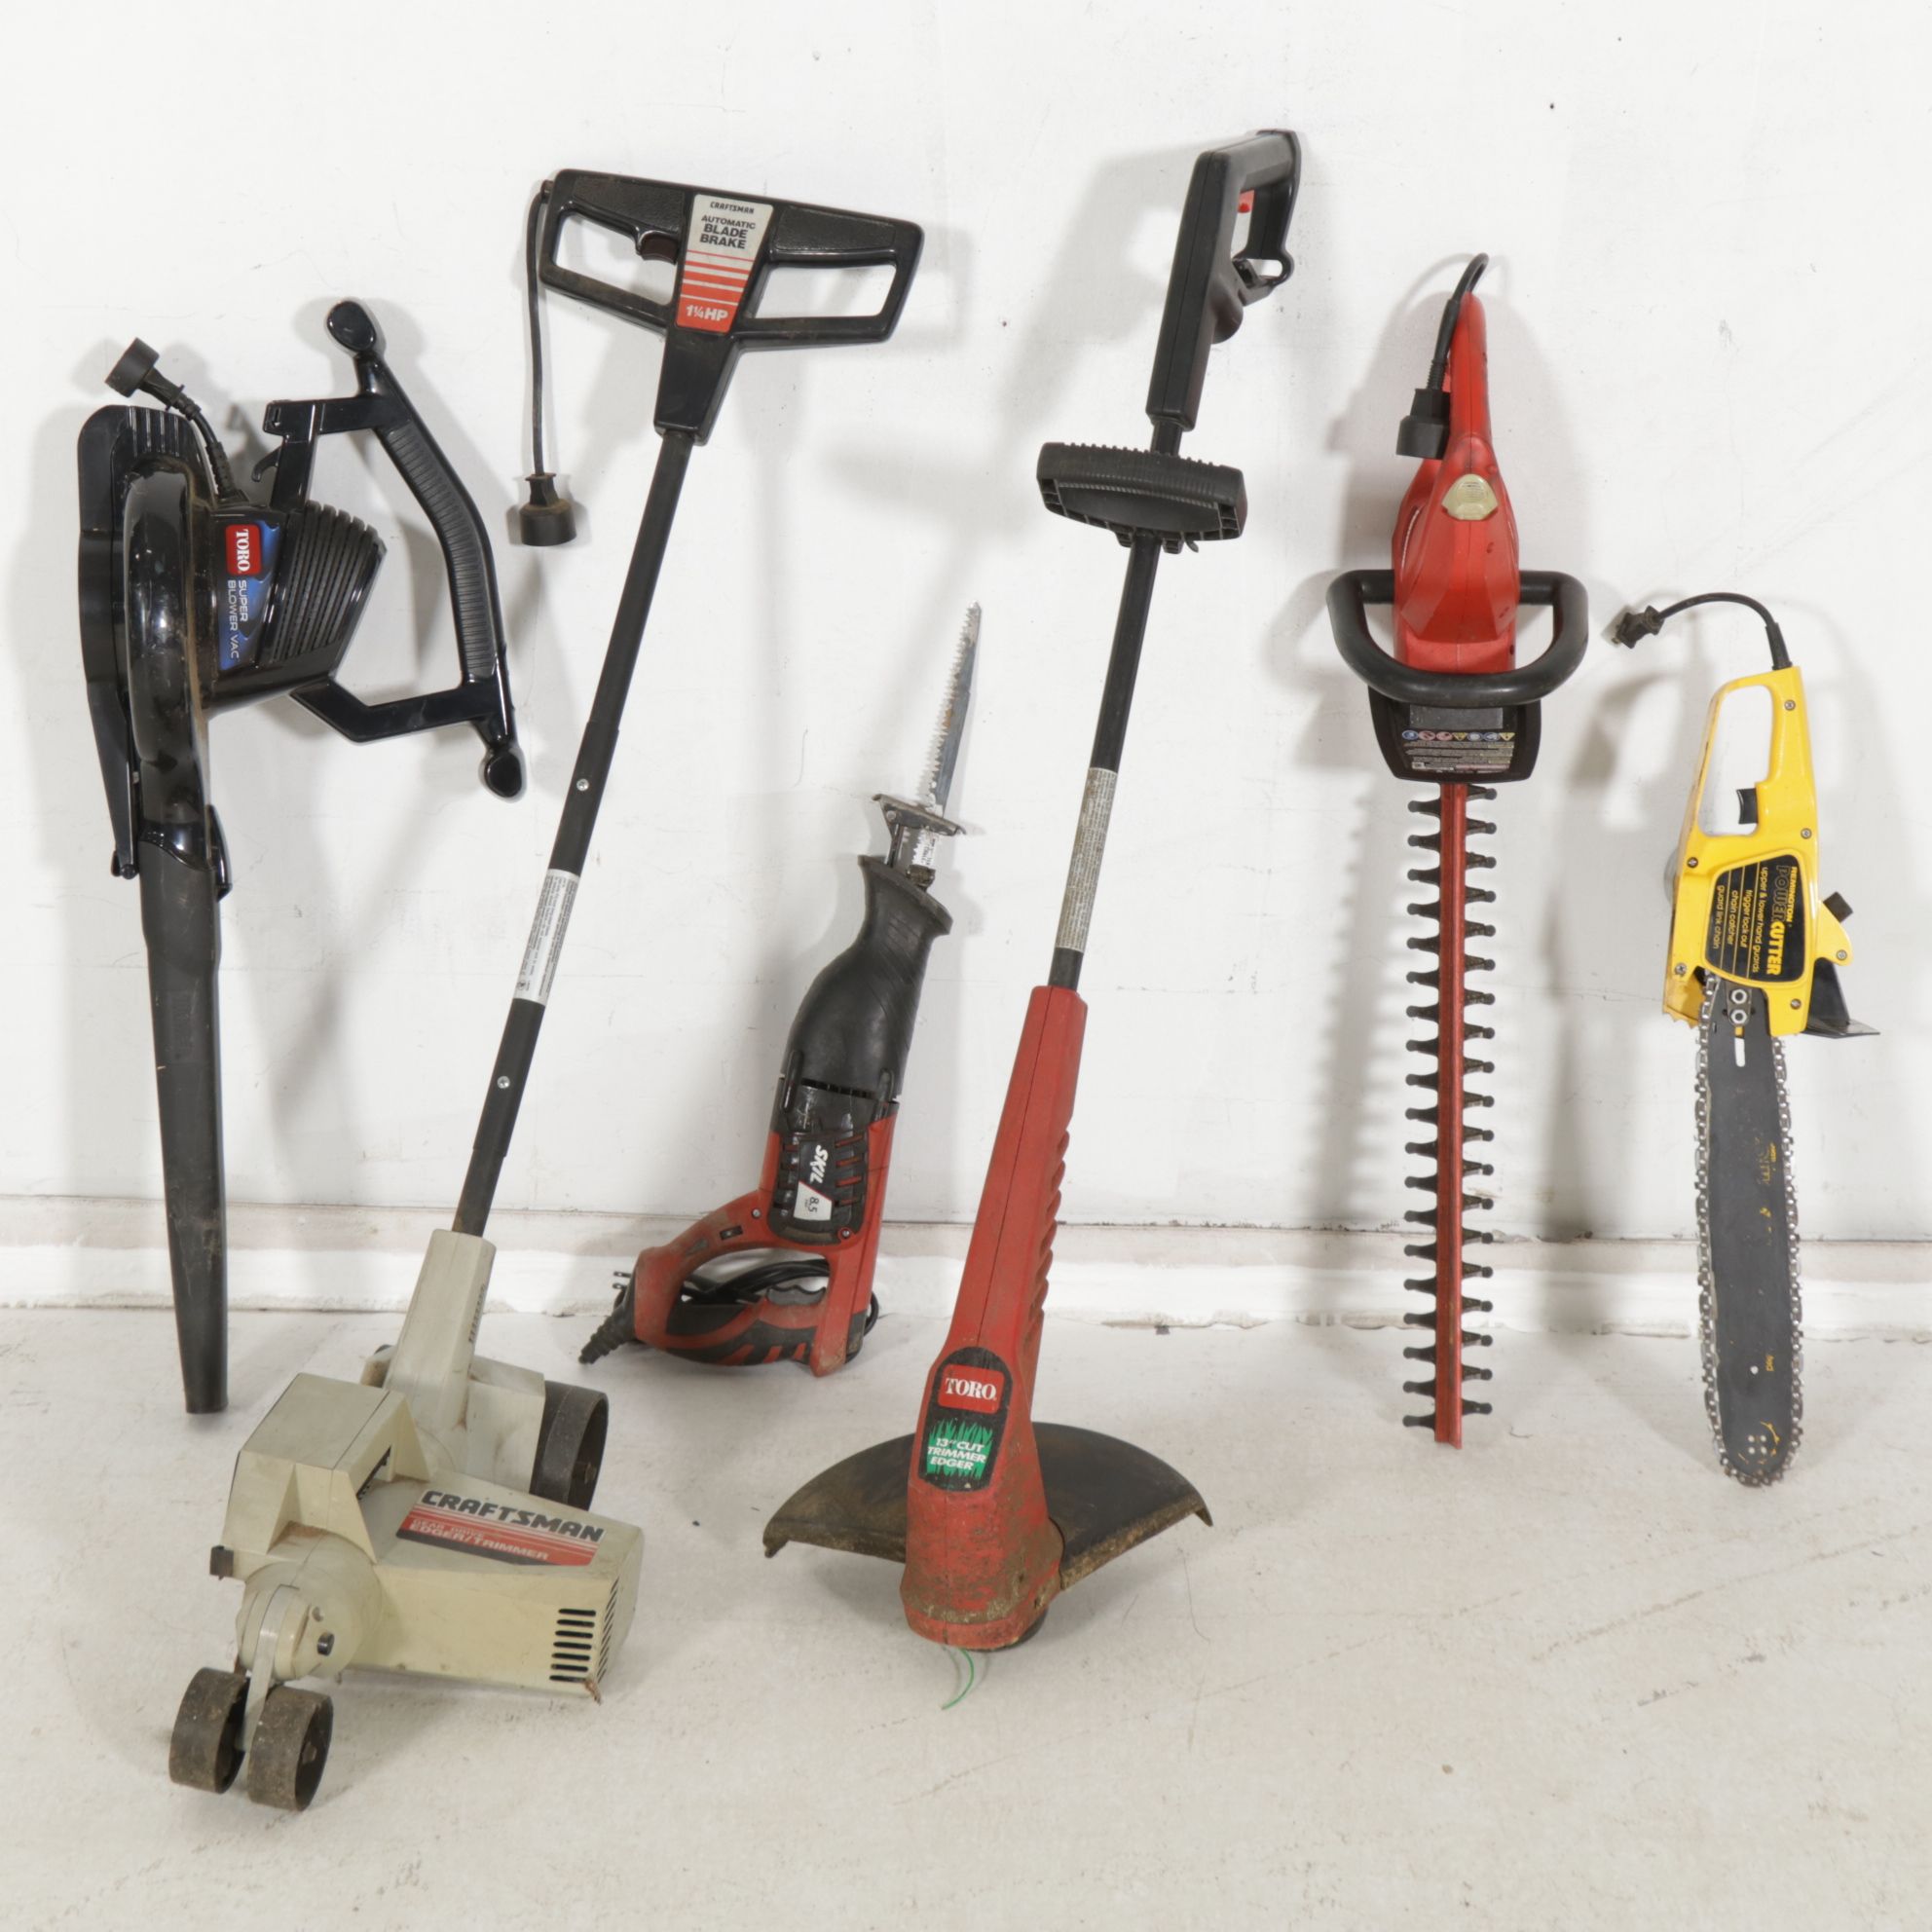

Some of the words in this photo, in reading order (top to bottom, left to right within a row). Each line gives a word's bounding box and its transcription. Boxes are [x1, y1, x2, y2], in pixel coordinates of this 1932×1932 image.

[710, 201, 755, 214] CRAFTSMAN
[701, 214, 756, 230] AUTOMATIC
[703, 223, 748, 240] BLADE
[699, 233, 747, 249] BRAKE
[236, 529, 250, 573] TORO
[227, 579, 239, 631] BLOWER
[238, 579, 248, 622] SUPER
[230, 634, 240, 659] VAC
[1759, 867, 1768, 891] upper
[1716, 885, 1726, 910] guard
[1730, 890, 1739, 912] chain
[1742, 889, 1753, 915] trigger
[1786, 866, 1798, 922] REMINGTON
[1715, 910, 1724, 925] link
[1756, 900, 1765, 922] lower
[1727, 913, 1737, 946] catcher
[1741, 916, 1751, 934] lock
[1754, 922, 1764, 944] hand
[1713, 925, 1723, 949] chain
[1740, 934, 1749, 947] out
[1752, 945, 1763, 973] guards
[809, 1144, 828, 1184] SKIL
[808, 1196, 819, 1213] 8.5
[946, 1378, 997, 1400] TORO
[927, 1446, 986, 1464] TRIMMER
[956, 1440, 985, 1453] CUT
[930, 1456, 974, 1470] EDGER
[422, 1490, 605, 1542] CRAFTSMAN
[409, 1523, 549, 1560] EDGER/TRIMMER
